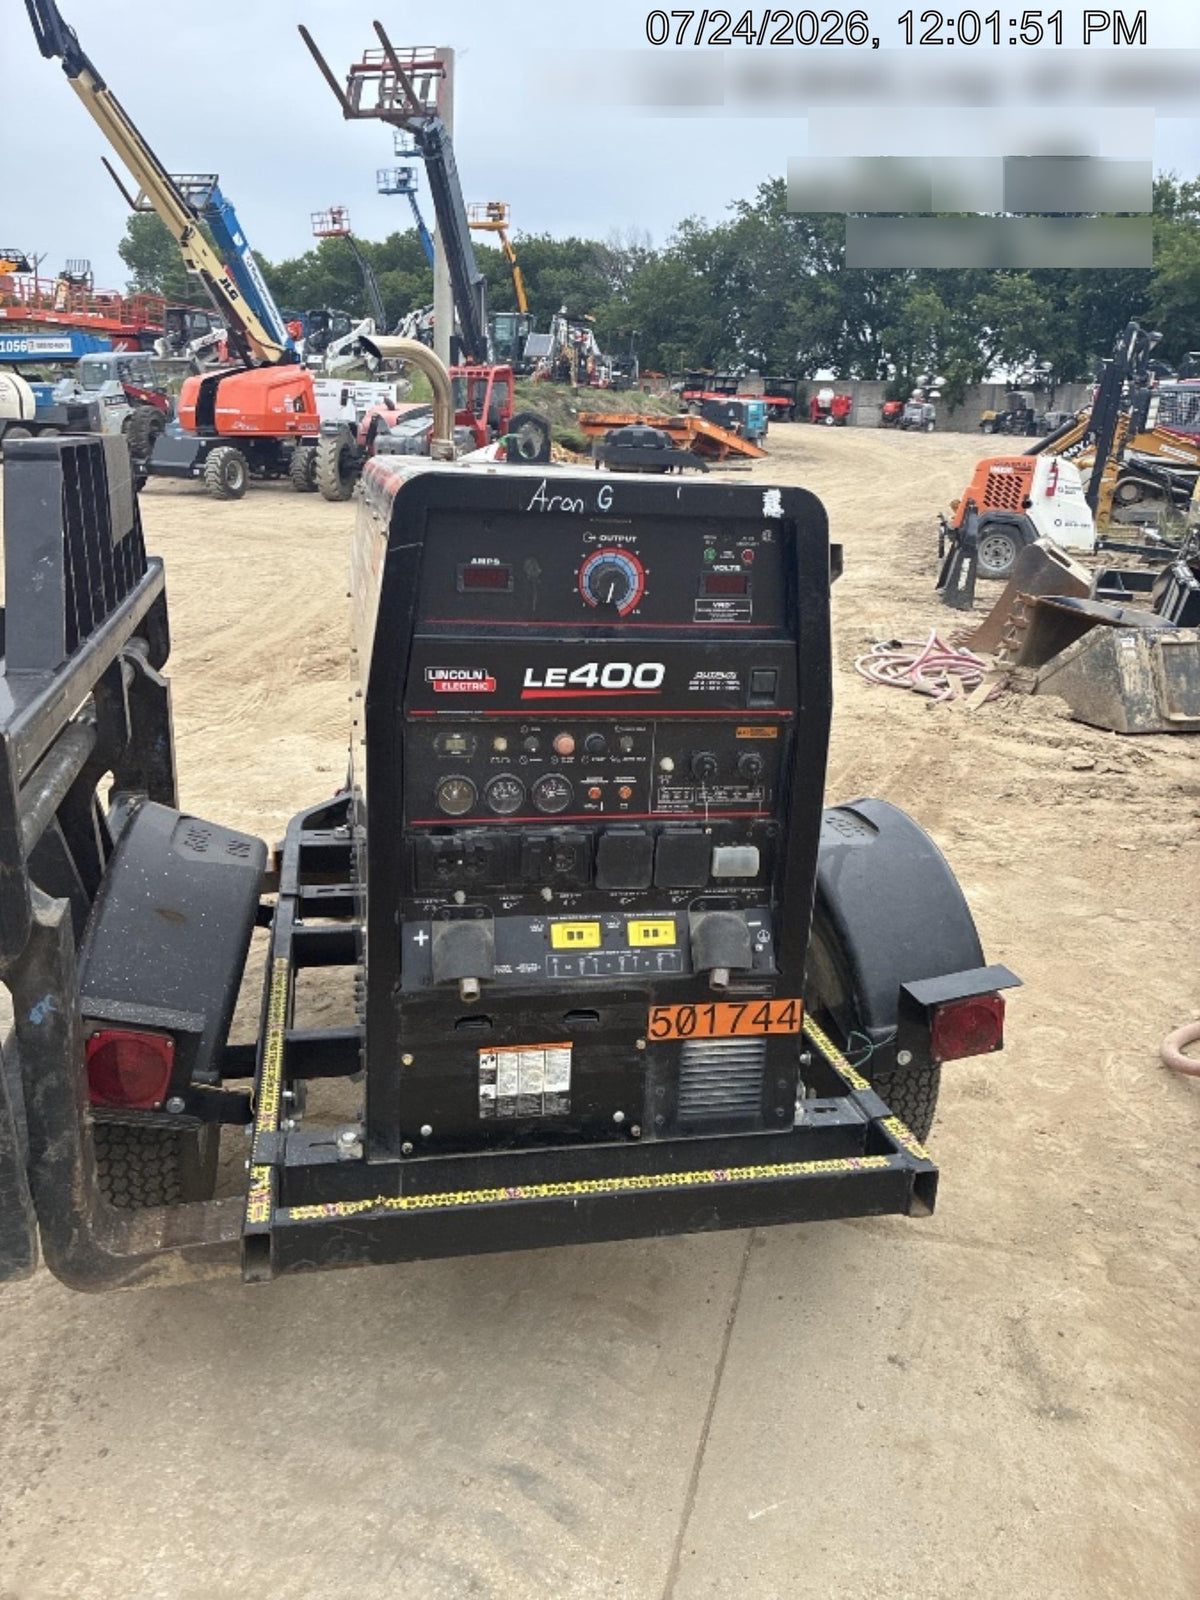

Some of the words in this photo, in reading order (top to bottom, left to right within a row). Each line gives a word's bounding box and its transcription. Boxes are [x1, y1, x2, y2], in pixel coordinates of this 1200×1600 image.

[218, 277, 239, 302] JLG
[526, 478, 585, 515] Aron
[596, 484, 615, 513] G
[600, 534, 638, 543] OUTPUT
[470, 557, 501, 566] AMPS
[712, 564, 742, 572] VOLTS
[428, 669, 486, 681] LINCOLN
[523, 662, 666, 689] LE400
[441, 682, 489, 691] ELECTRIC
[650, 1000, 798, 1038] 501744
